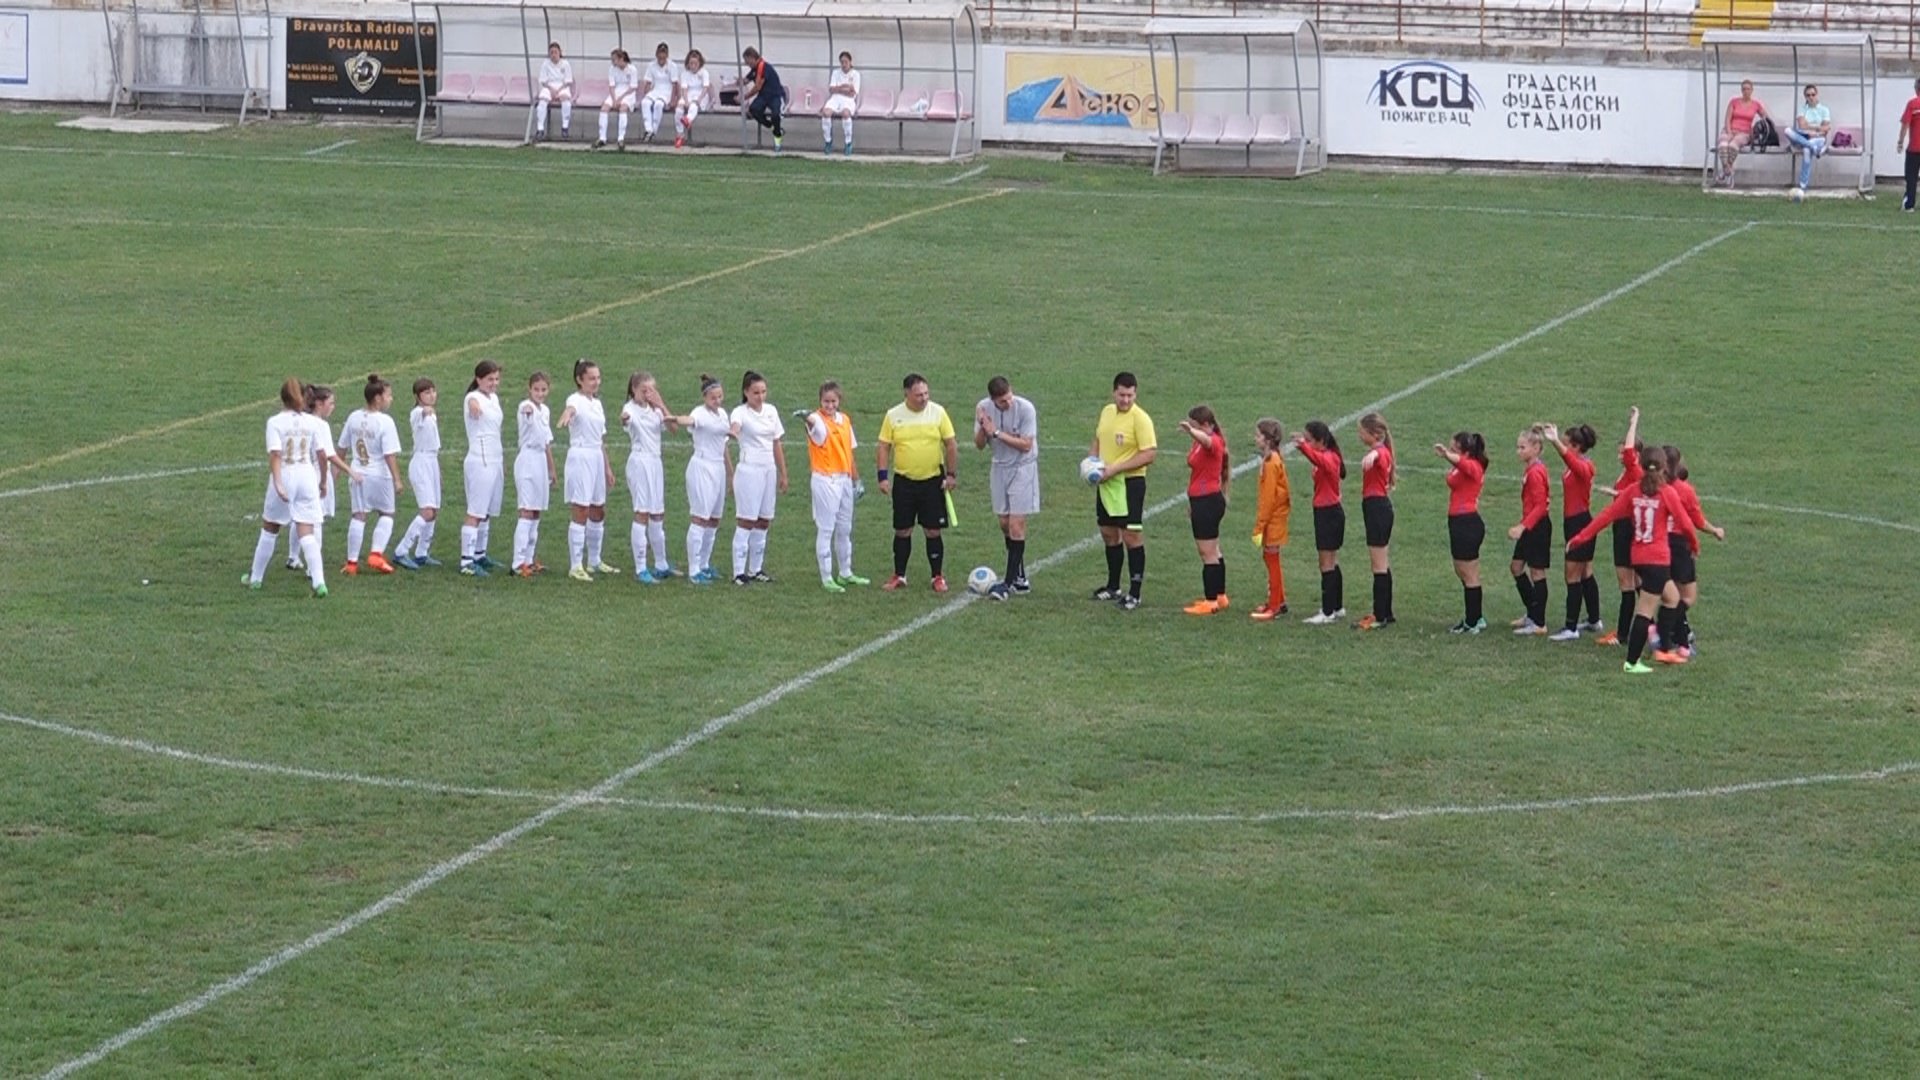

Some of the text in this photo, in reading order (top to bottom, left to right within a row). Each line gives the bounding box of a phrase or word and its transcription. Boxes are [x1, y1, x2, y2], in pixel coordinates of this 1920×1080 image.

[293, 19, 435, 36] Bravarska Radionca
[328, 37, 399, 51] POLAMALU
[1380, 69, 1475, 112] КСЦ
[1507, 73, 1597, 92] ГРАДСКИ
[1502, 92, 1620, 112] ФУДБАЛСКИ
[1507, 111, 1602, 131] СТАДИОН
[1633, 505, 1655, 543] 11
